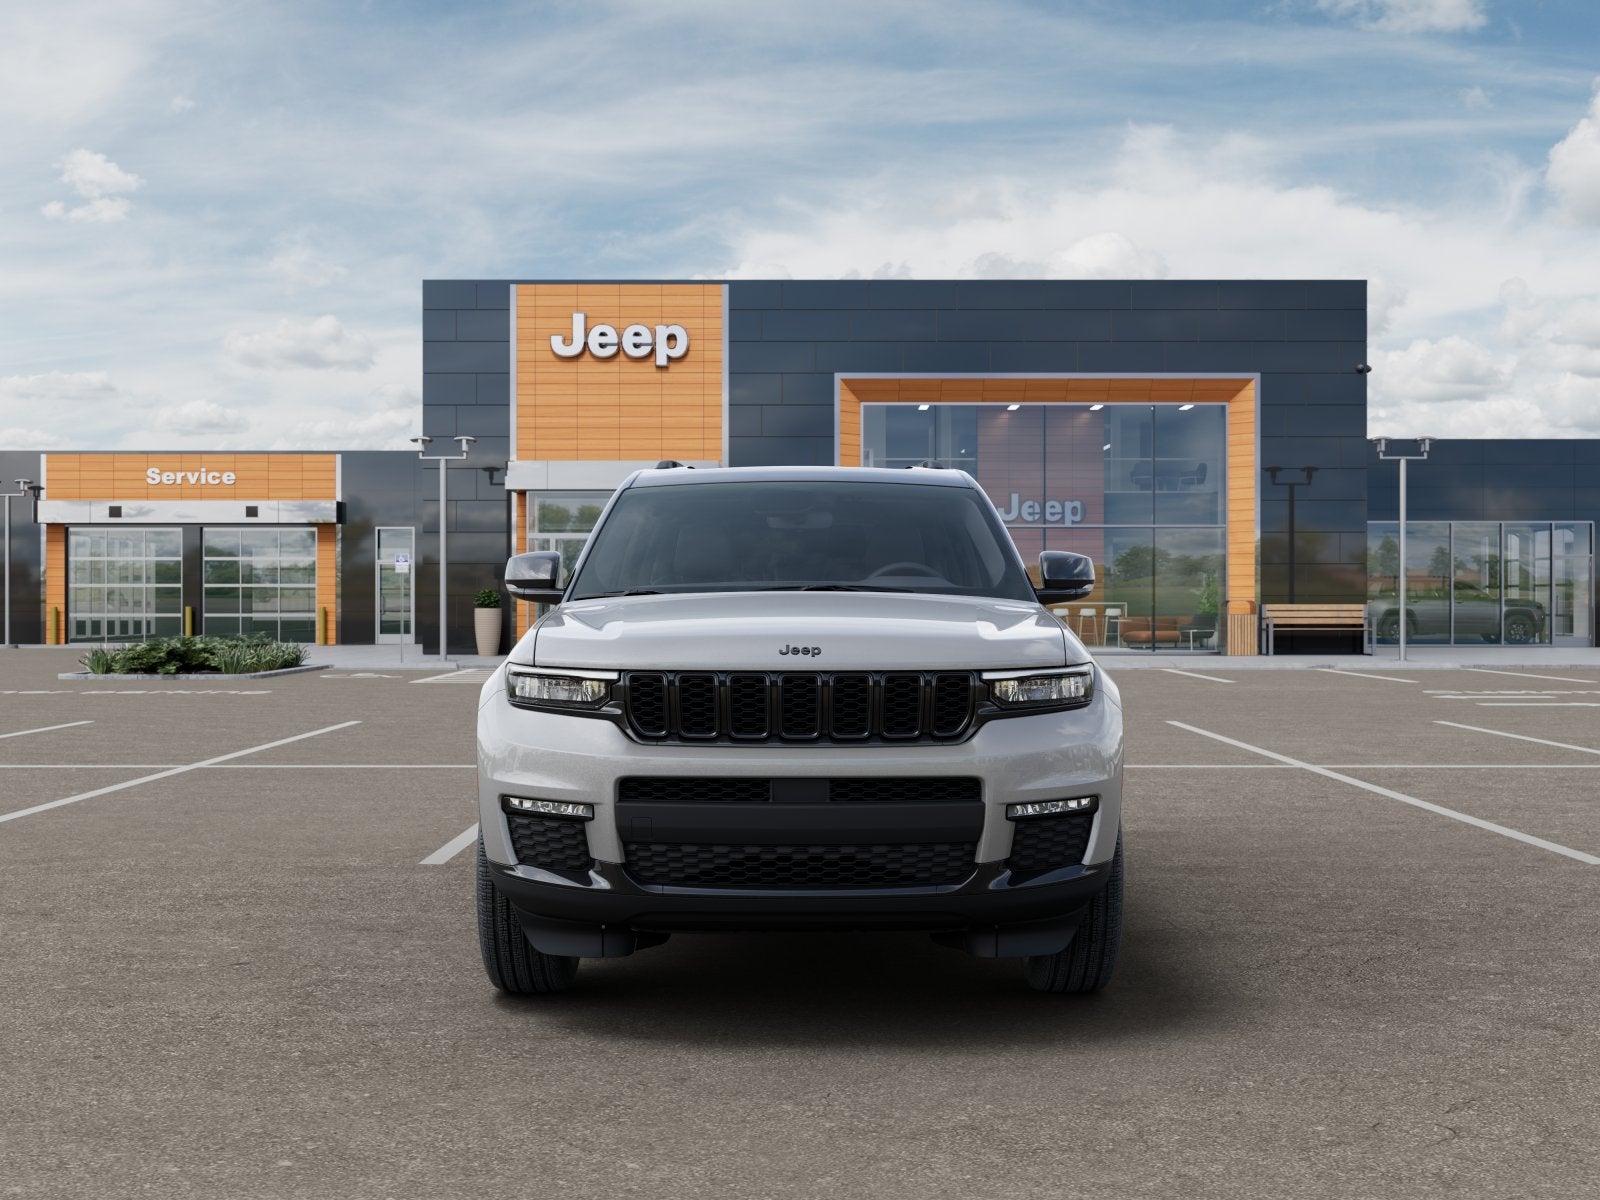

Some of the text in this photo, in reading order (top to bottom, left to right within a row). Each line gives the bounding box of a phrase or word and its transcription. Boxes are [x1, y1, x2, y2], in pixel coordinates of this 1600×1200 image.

[550, 312, 689, 367] Jeep
[146, 467, 236, 485] Service
[997, 493, 1084, 527] Jeep
[778, 644, 822, 658] Jeep
